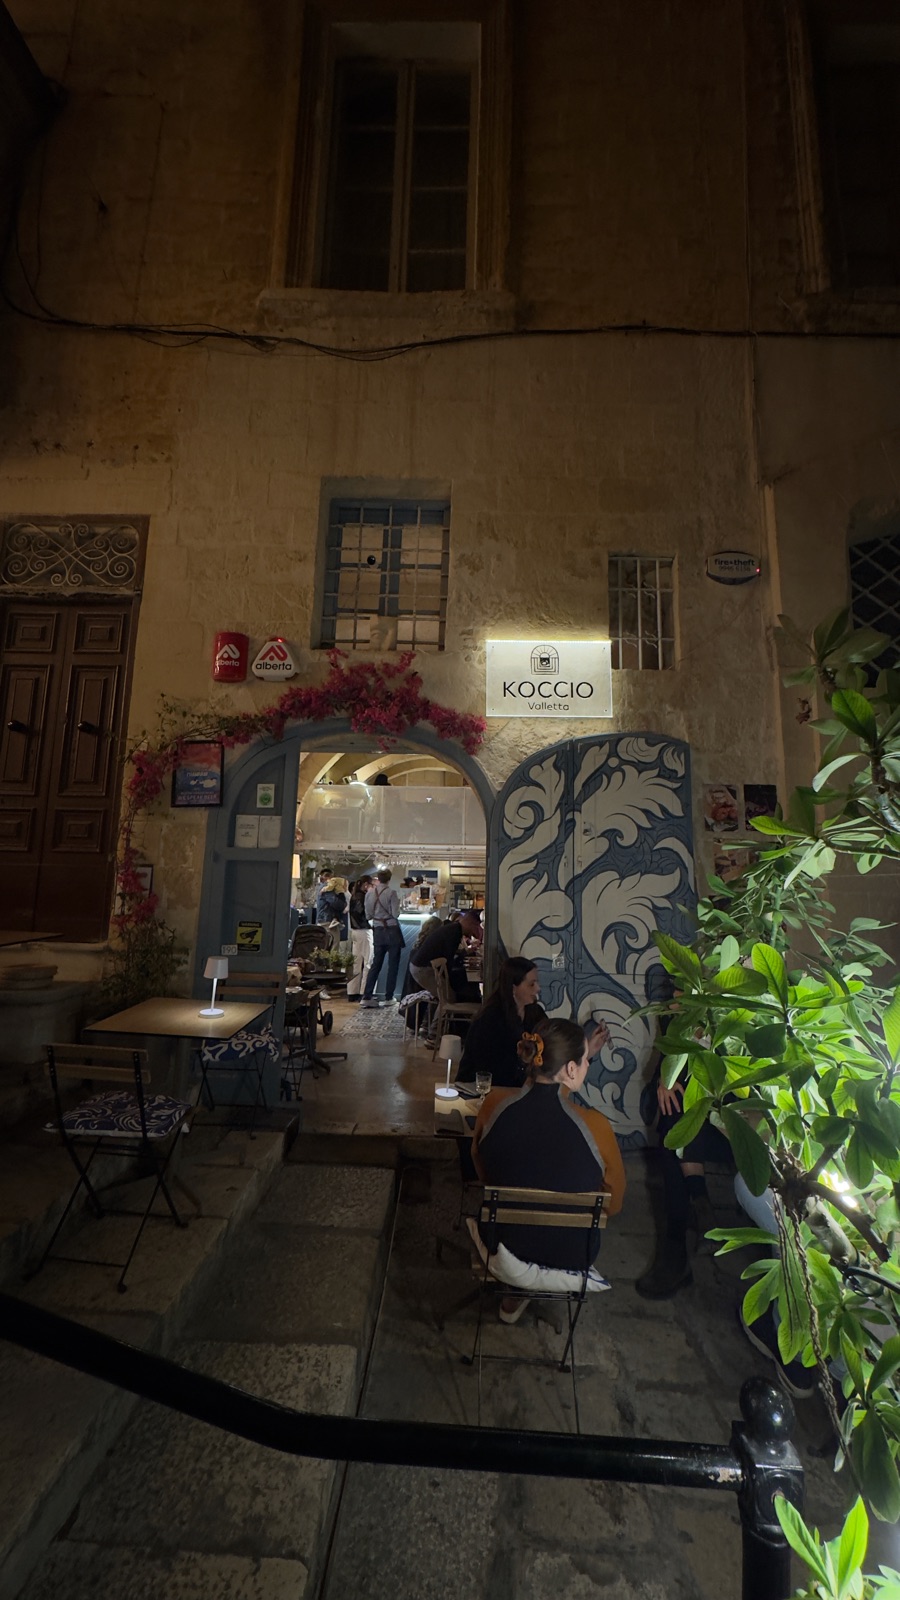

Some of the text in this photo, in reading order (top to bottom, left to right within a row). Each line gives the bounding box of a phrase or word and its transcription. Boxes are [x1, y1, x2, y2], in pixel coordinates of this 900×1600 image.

[215, 659, 240, 667] alberta
[255, 661, 292, 671] alberta
[503, 681, 594, 699] KOCCIO
[527, 702, 570, 711] Valletta
[222, 946, 237, 954] 190
